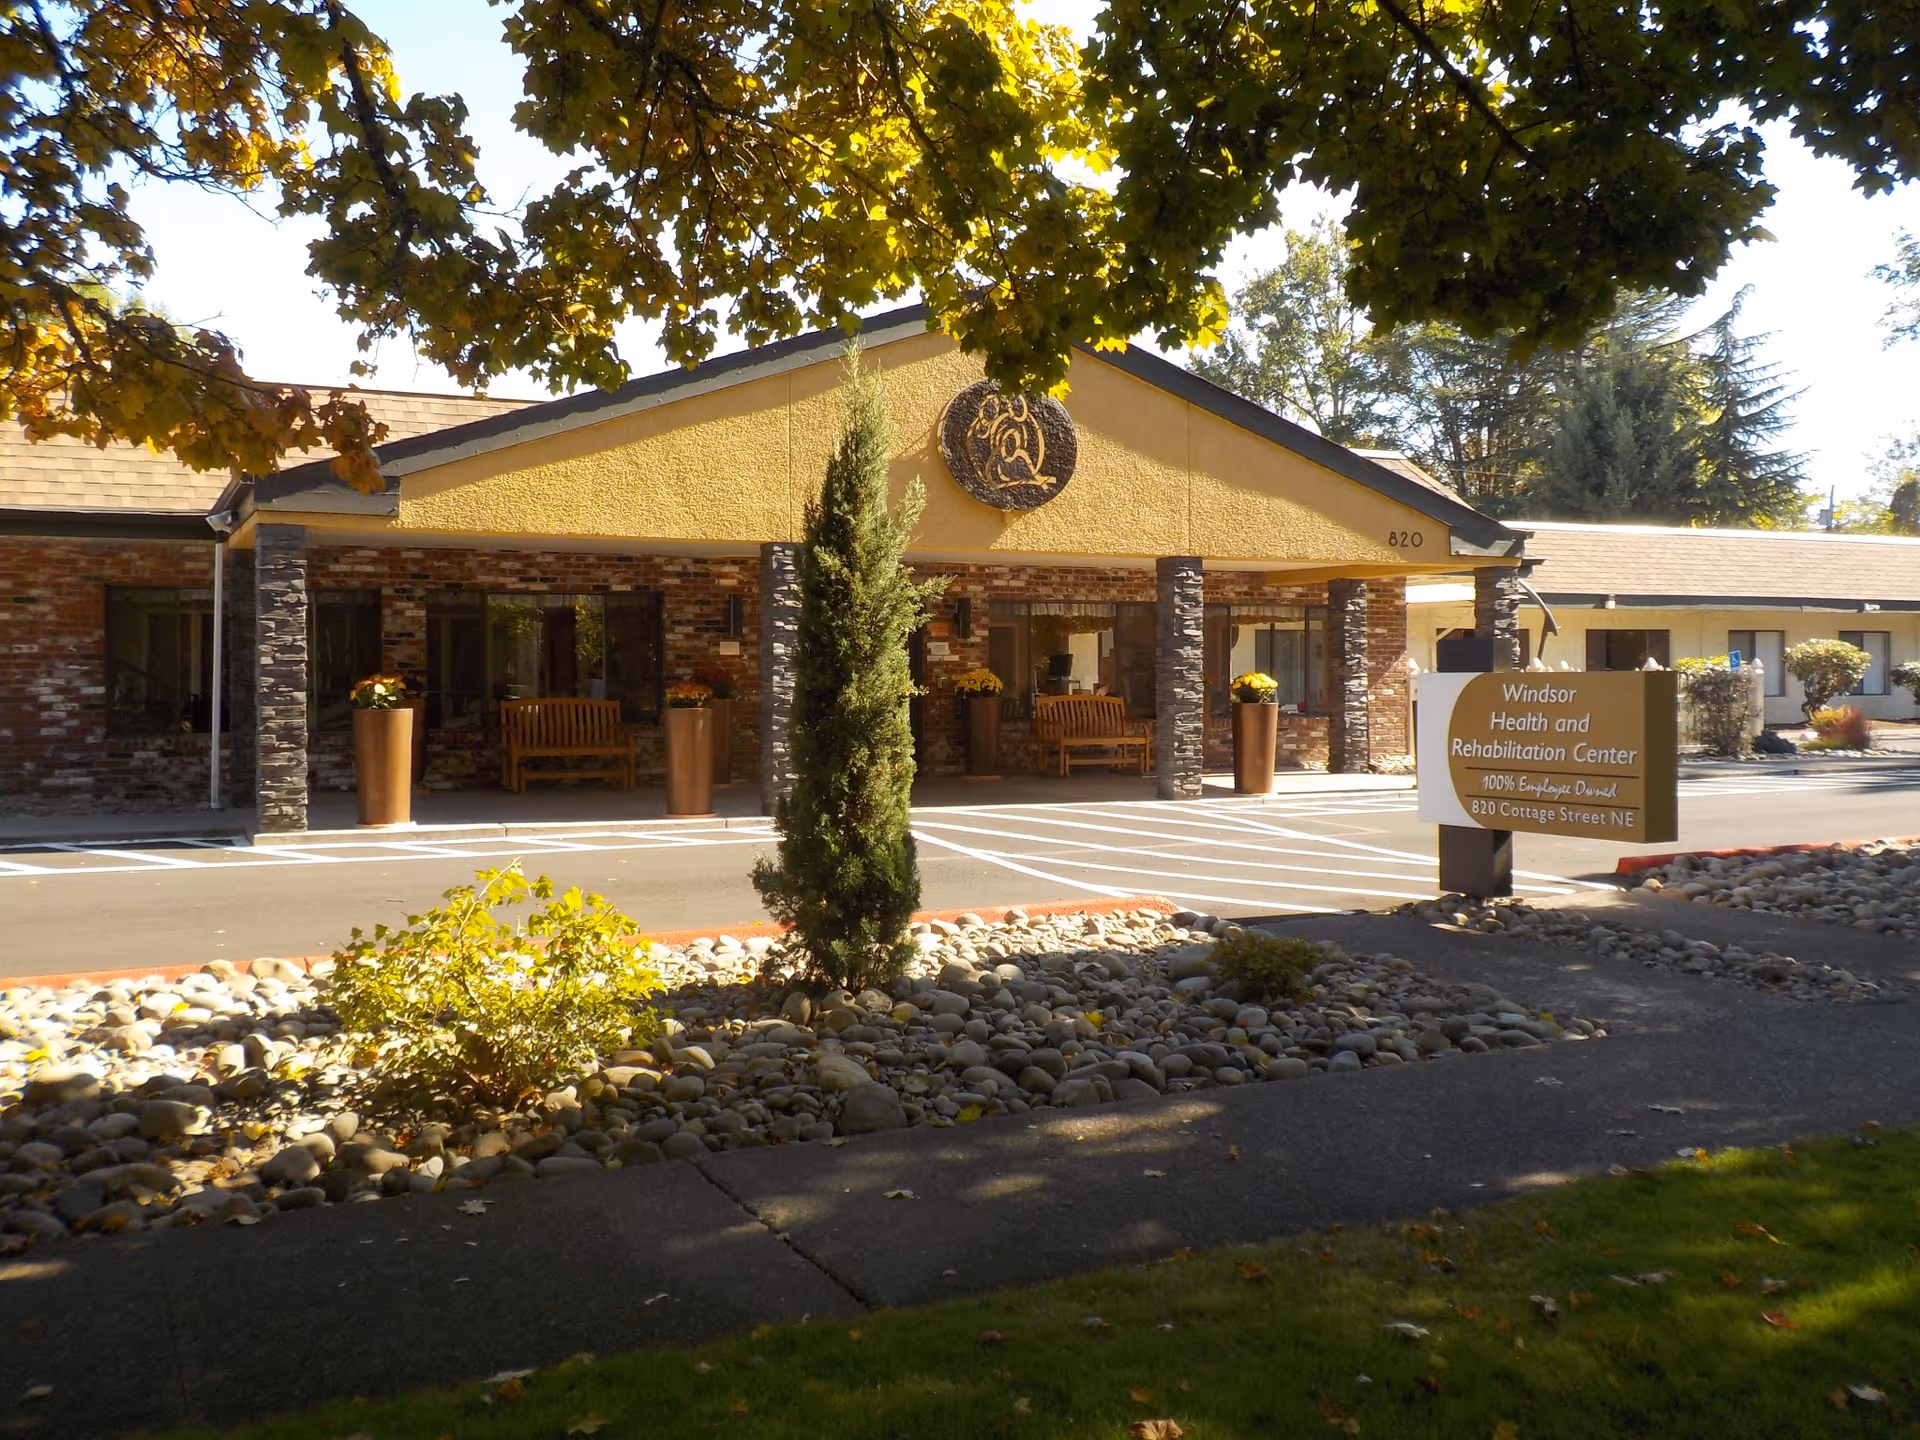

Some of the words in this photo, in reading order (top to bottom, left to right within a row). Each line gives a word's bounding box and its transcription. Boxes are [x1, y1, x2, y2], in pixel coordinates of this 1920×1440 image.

[1388, 531, 1423, 548] 820
[1503, 683, 1577, 703] Windsor
[1490, 712, 1548, 732] Health
[1555, 713, 1590, 733] and
[1451, 738, 1566, 762] Rehabilitation
[1573, 742, 1637, 765] Center
[1481, 774, 1515, 792] 100%
[1519, 777, 1571, 800] Employee
[1575, 781, 1619, 798] Owned
[1472, 800, 1496, 816] 820
[1500, 802, 1556, 824] Cottage
[1560, 808, 1606, 826] Street
[1611, 811, 1635, 827] NE
